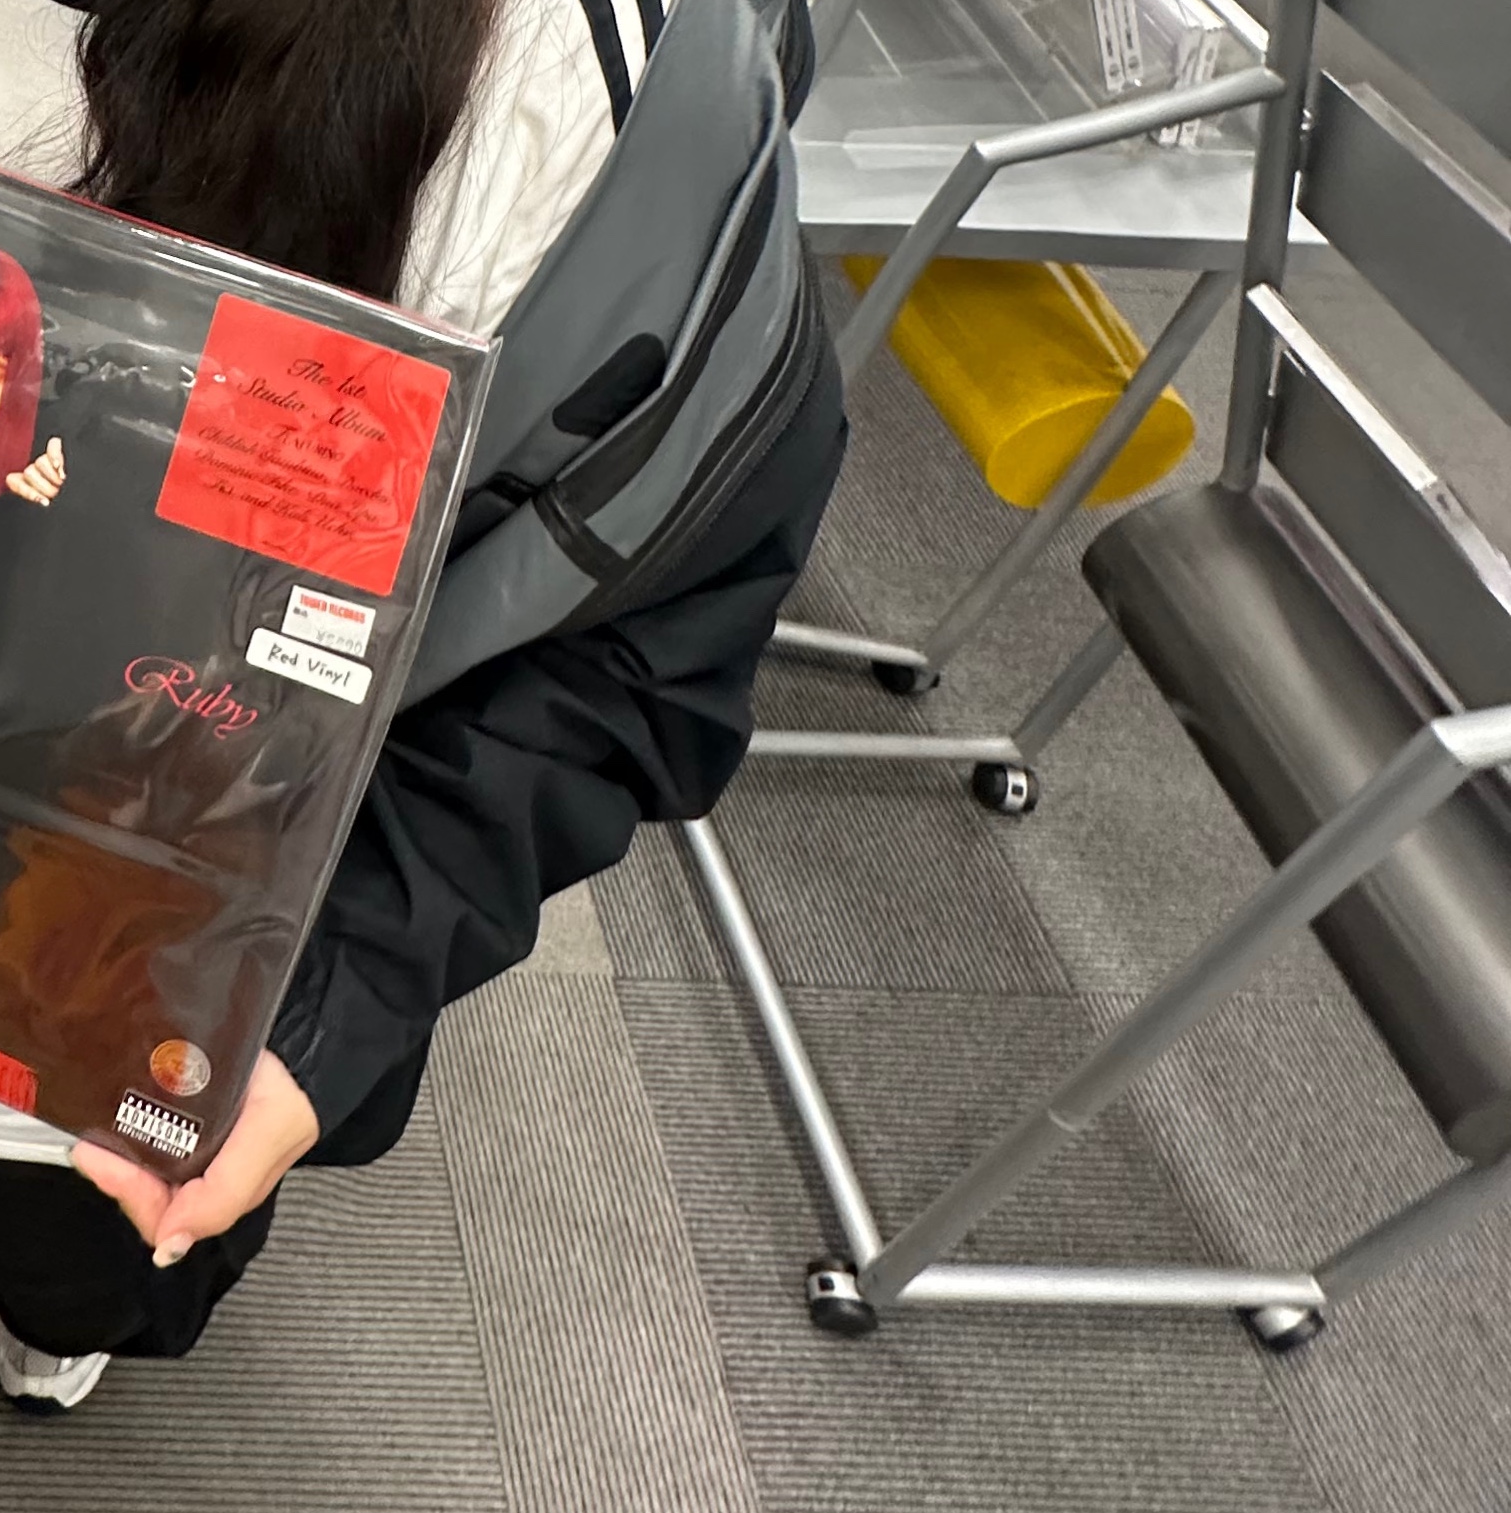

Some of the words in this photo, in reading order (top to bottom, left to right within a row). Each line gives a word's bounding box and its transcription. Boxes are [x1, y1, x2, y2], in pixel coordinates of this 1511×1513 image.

[236, 378, 307, 413] Studio
[286, 359, 333, 387] The
[337, 376, 367, 399] 1st
[268, 643, 298, 666] Red
[308, 658, 351, 687] Vinyl
[124, 654, 259, 740] Ruby
[121, 1107, 192, 1148] ADVISORY
